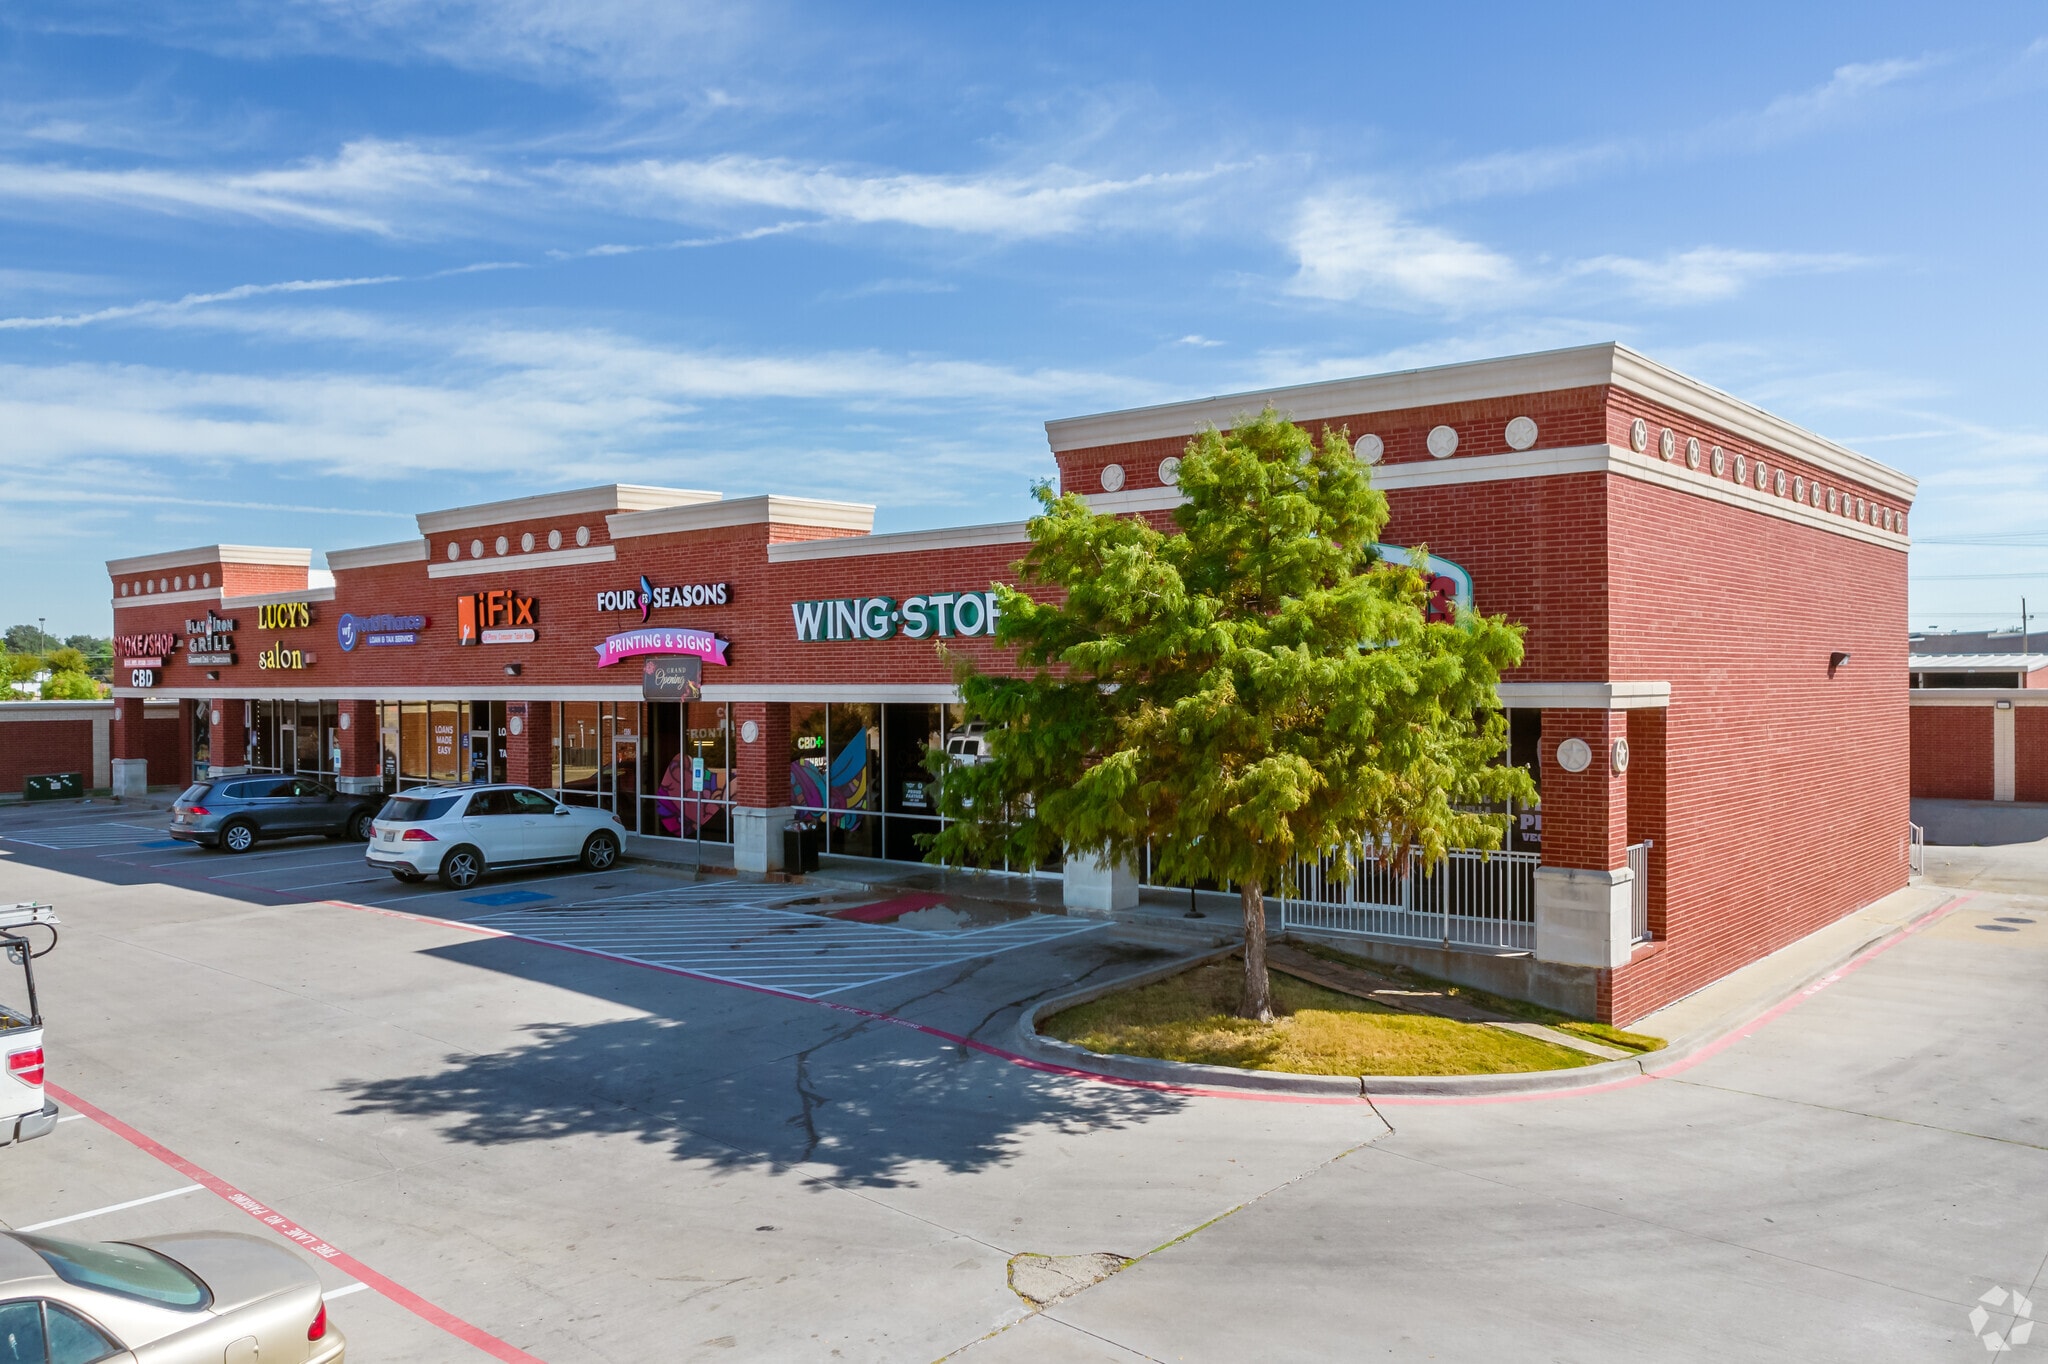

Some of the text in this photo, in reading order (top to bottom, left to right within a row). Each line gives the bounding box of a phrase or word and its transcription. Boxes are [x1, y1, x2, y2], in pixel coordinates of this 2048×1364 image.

[596, 589, 637, 611] FOUR
[652, 583, 727, 608] SEASONS
[257, 602, 310, 630] LUCY'S
[478, 589, 534, 627] iFix
[212, 616, 233, 632] IRON
[188, 634, 231, 653] GRILL
[369, 636, 381, 644] LOAN
[386, 635, 394, 643] TAX
[394, 634, 414, 643] SERVICE
[608, 633, 712, 655] PRINTING & SIGNS
[258, 641, 303, 670] salon
[131, 669, 153, 688] CBD
[655, 668, 686, 690] Opening
[434, 725, 454, 735] LOANS
[436, 735, 453, 745] MADE
[437, 745, 452, 755] EASY
[228, 1193, 269, 1215] PARKING
[264, 1215, 286, 1225] NO
[284, 1227, 317, 1245] LANE
[310, 1243, 341, 1258] FIRE
